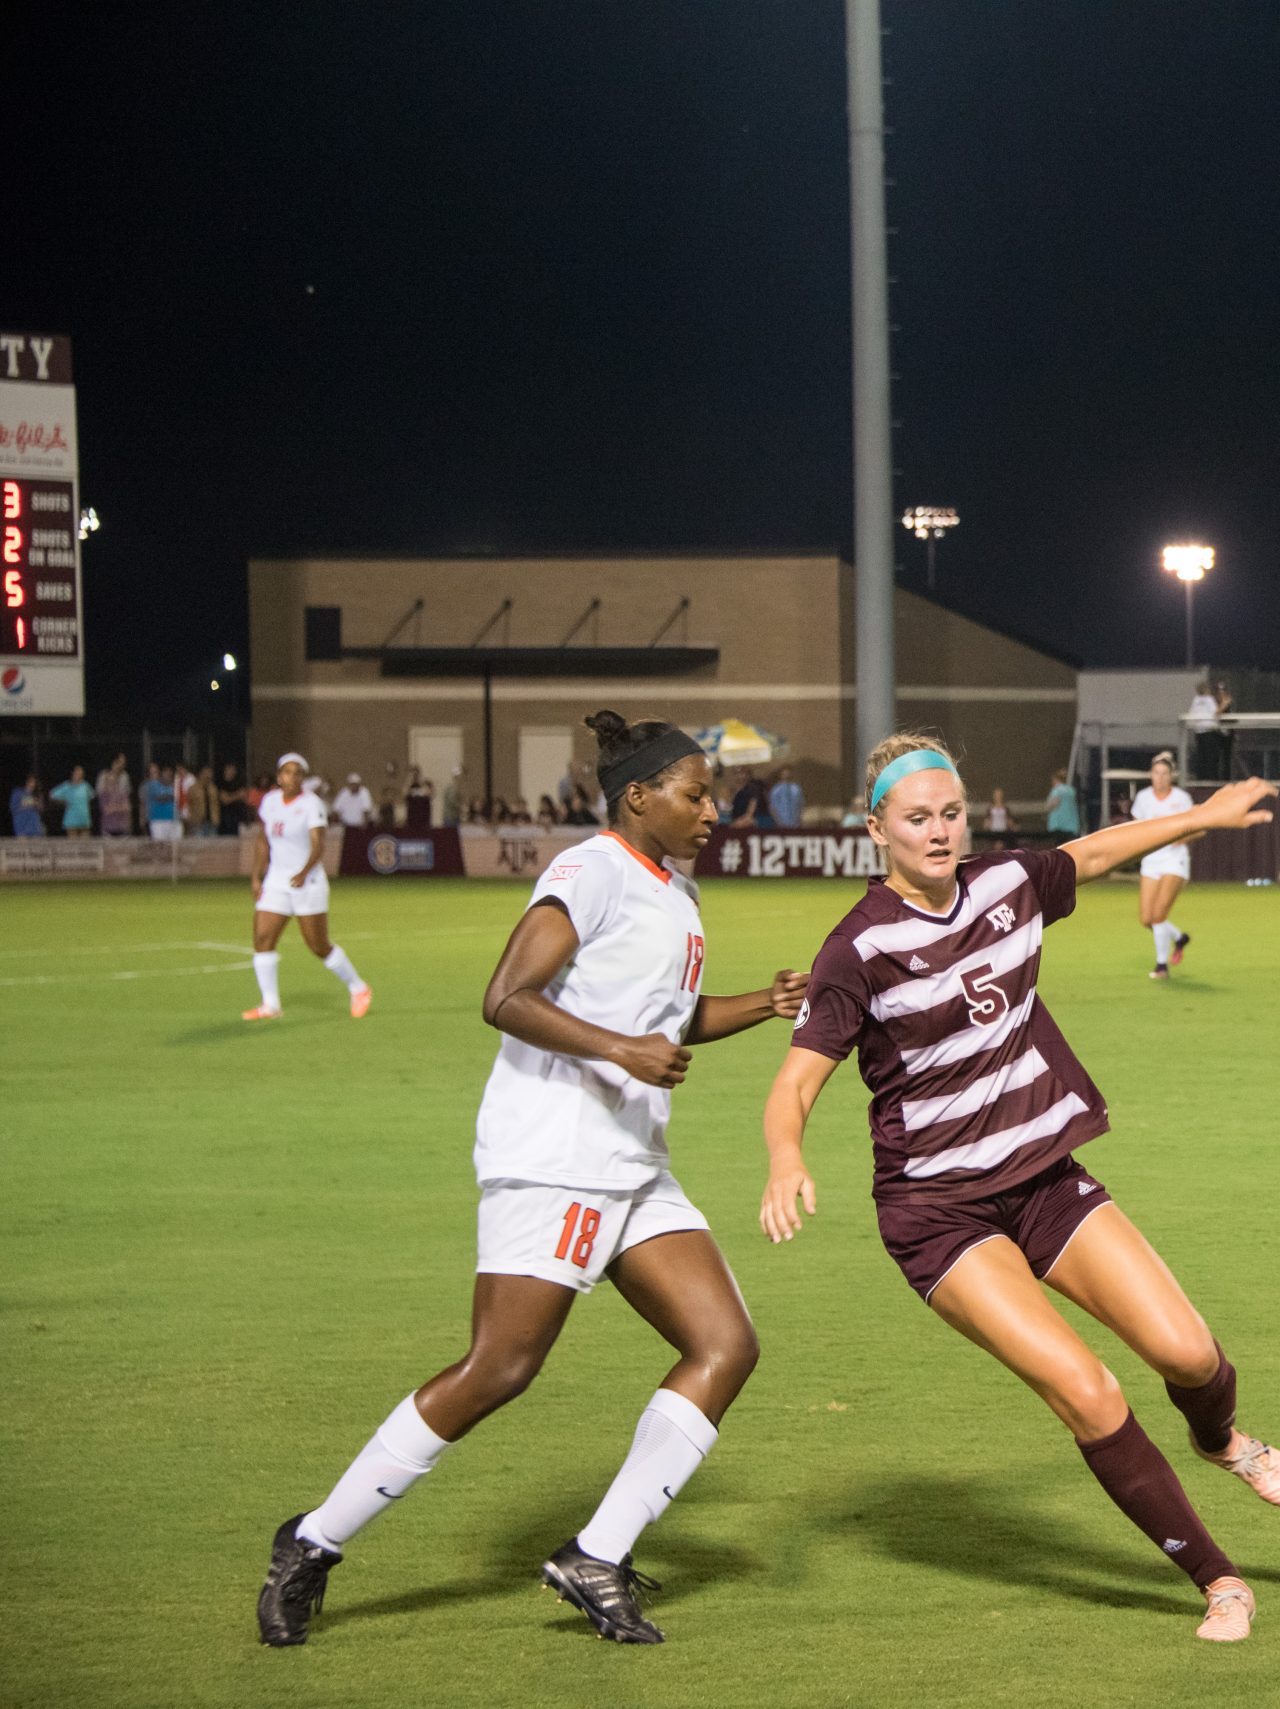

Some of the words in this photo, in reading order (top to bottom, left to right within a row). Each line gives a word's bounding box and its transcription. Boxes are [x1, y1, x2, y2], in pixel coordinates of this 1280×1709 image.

[4, 482, 20, 518] 3
[32, 491, 70, 513] SHOTS
[4, 526, 22, 562] 2
[5, 571, 23, 607] 5
[16, 616, 24, 648] 1
[959, 962, 1010, 1029] 5
[554, 1201, 602, 1269] 18
